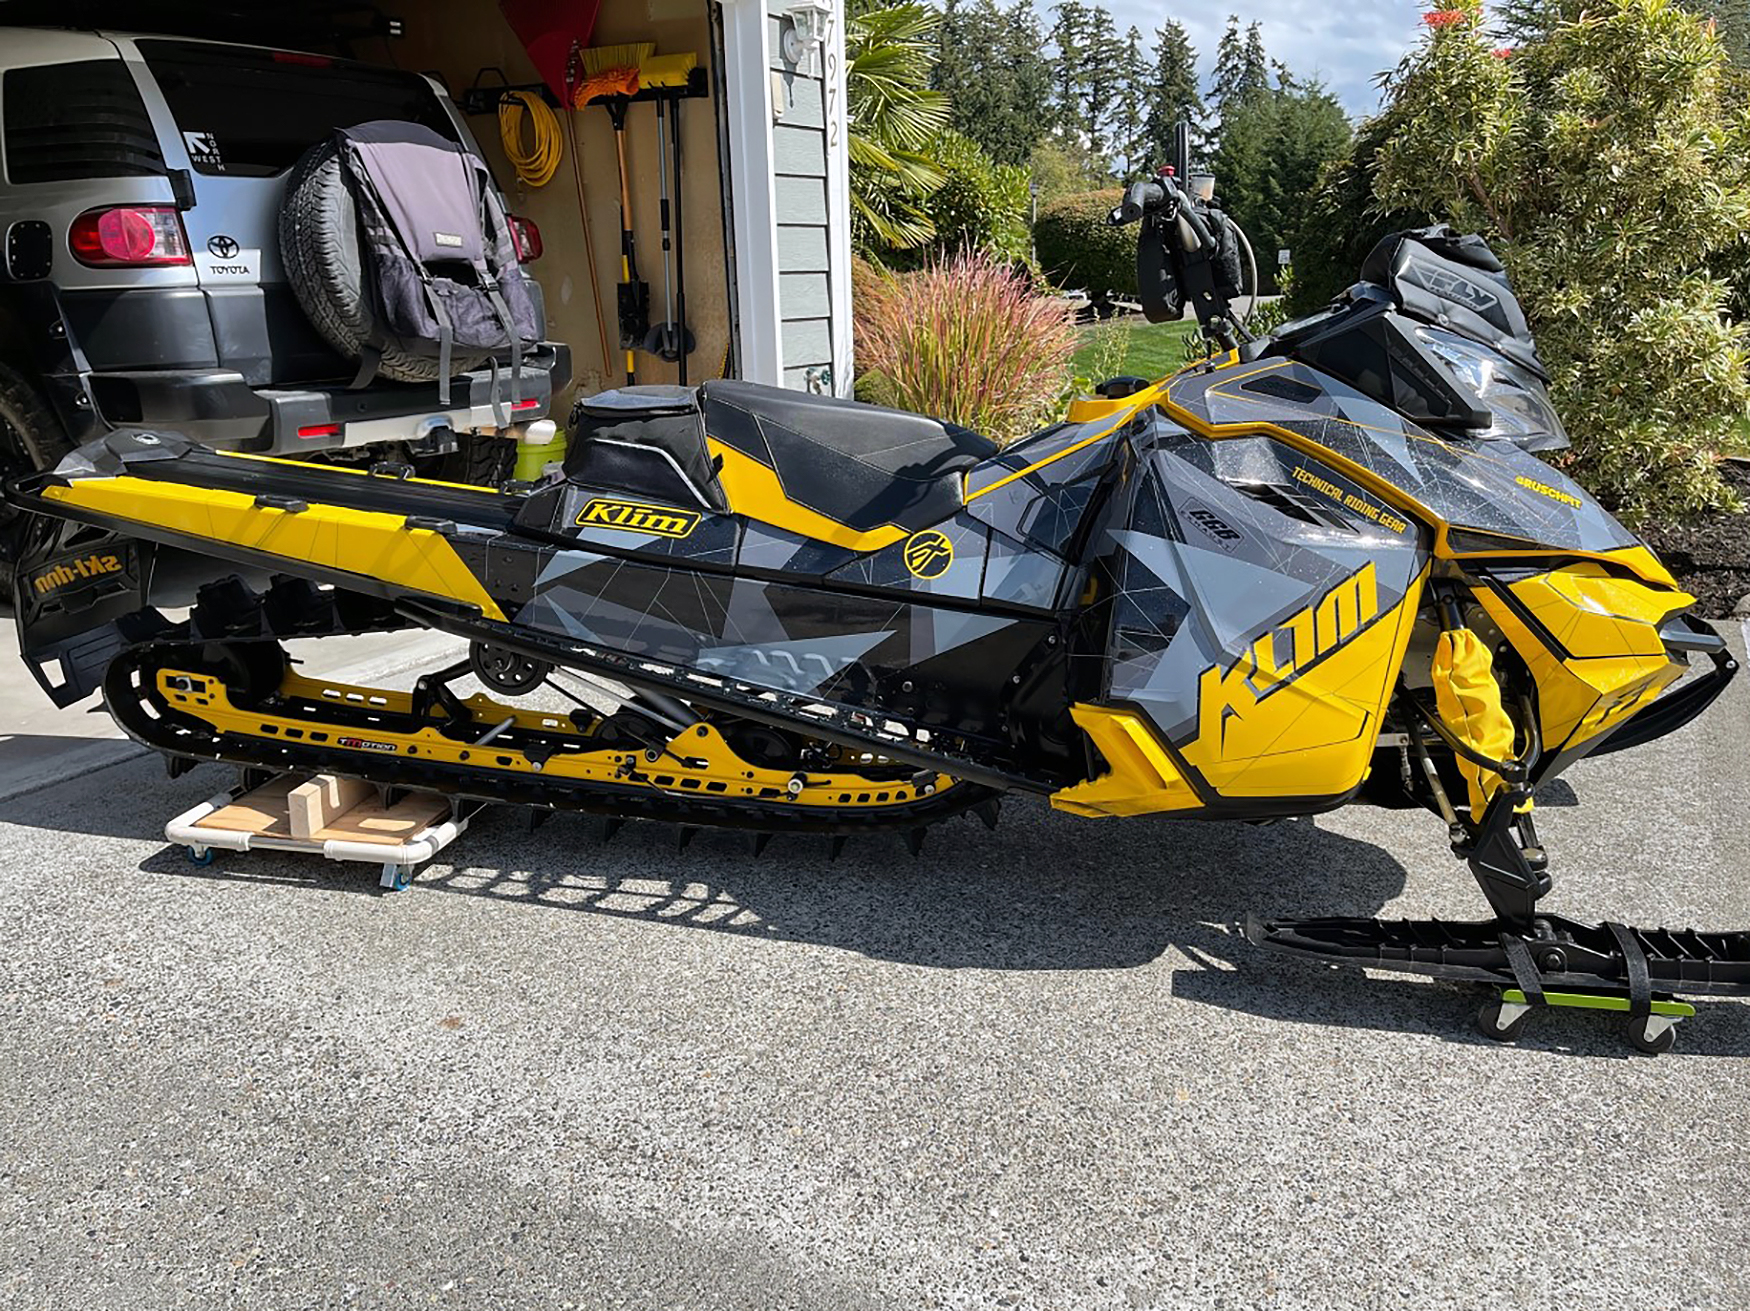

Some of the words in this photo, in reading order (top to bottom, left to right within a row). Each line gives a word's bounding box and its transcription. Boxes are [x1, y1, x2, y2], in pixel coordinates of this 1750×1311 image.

[205, 132, 226, 171] NORTH
[210, 266, 250, 275] TOYOTA
[1428, 268, 1495, 306] FLY
[1292, 466, 1344, 502] TECHNICAL
[1343, 495, 1381, 520] RIDING
[1379, 512, 1407, 534] GEAR
